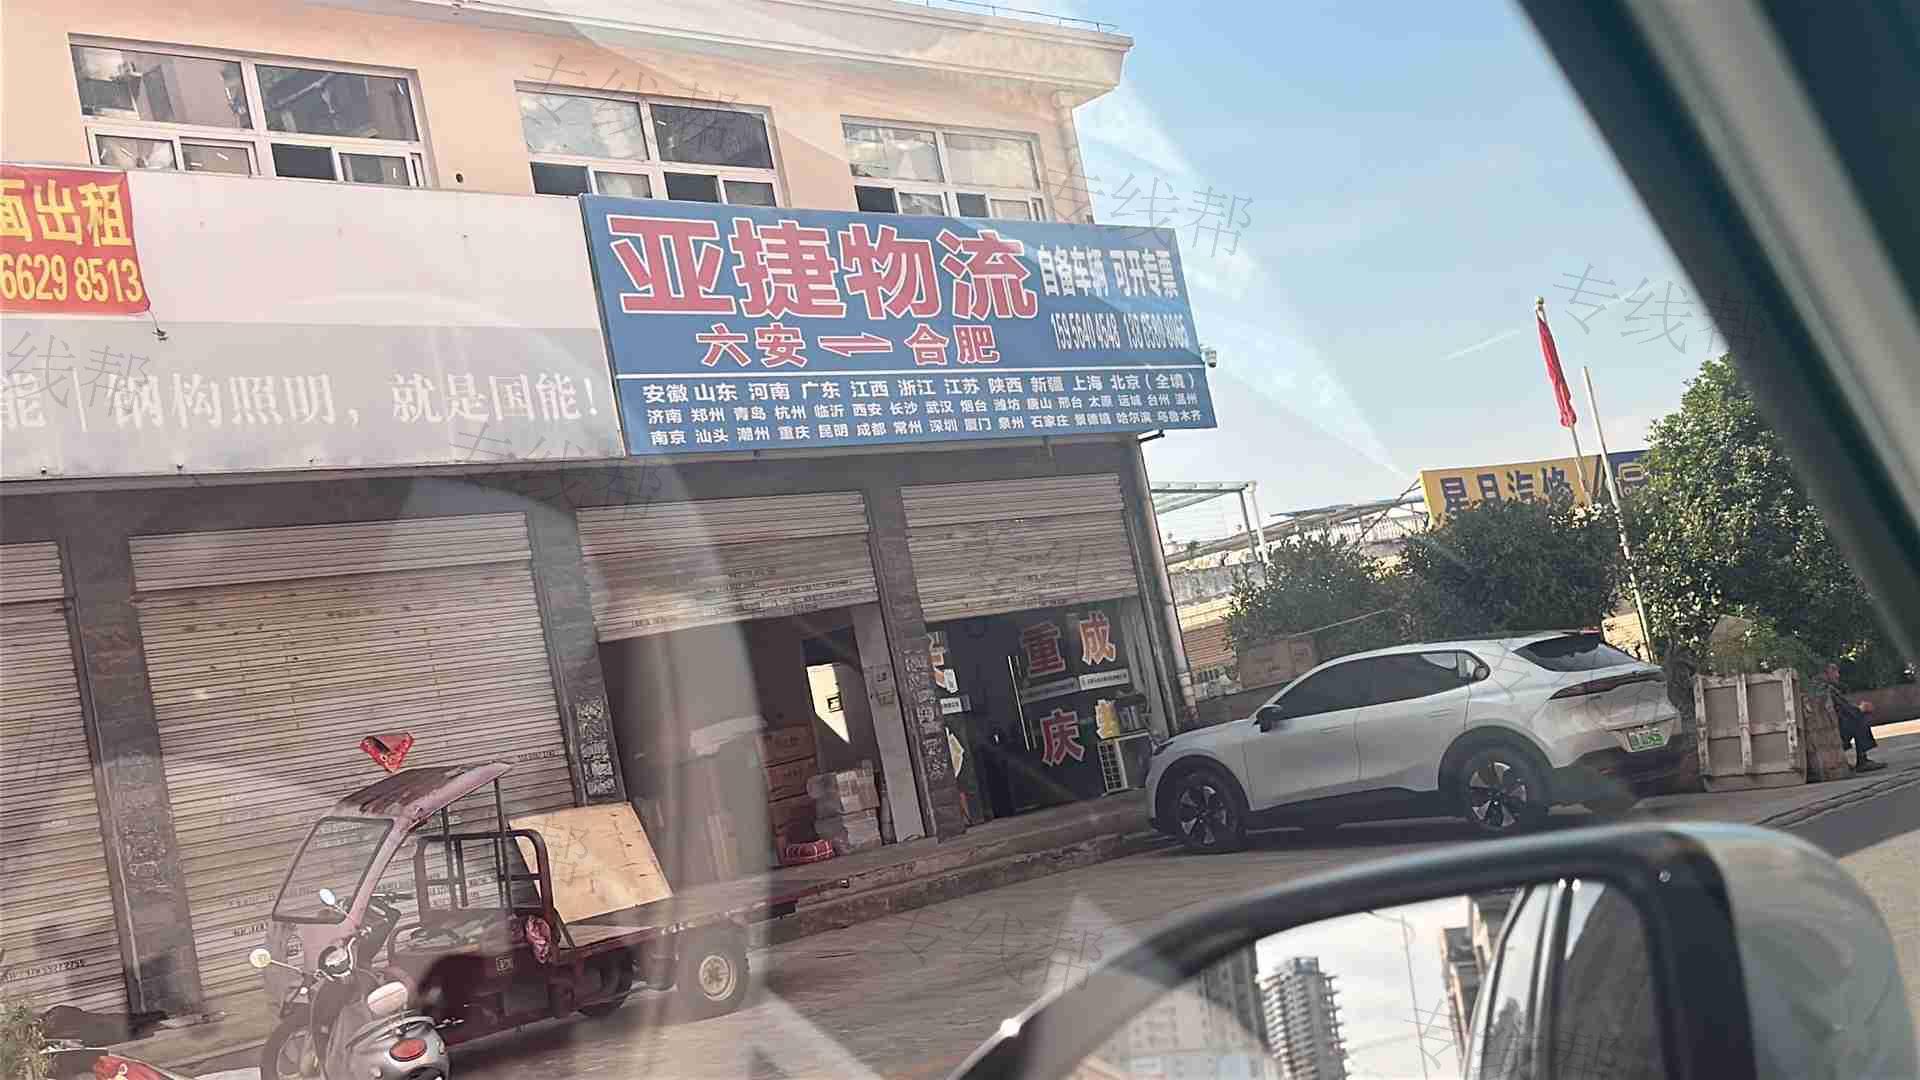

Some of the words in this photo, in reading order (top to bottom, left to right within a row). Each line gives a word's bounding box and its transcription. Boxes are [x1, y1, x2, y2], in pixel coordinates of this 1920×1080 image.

[0, 178, 133, 247] 面出租
[0, 253, 67, 301] 6629
[74, 256, 144, 302] 8513
[606, 213, 1039, 321] 亚捷物流
[1038, 244, 1108, 297] 自备车辆
[1110, 248, 1178, 299] 可开专票
[696, 322, 808, 369] 六安
[905, 324, 1002, 366] 合肥
[643, 384, 688, 404] 安徽
[694, 383, 737, 402] 山东
[748, 382, 791, 401] 河南
[800, 381, 840, 400] 广东
[851, 380, 889, 398] 江西
[897, 378, 936, 397] 浙江
[944, 377, 979, 394] 江苏
[988, 376, 1023, 394] 陕西
[1030, 375, 1064, 393] 新疆
[1072, 374, 1103, 391] 上海
[647, 407, 683, 425] 济南
[690, 406, 726, 423] 郑州
[733, 406, 766, 422] 青岛
[774, 405, 807, 420] 杭州
[814, 403, 846, 419] 临沂
[852, 402, 882, 418] 西安
[889, 400, 918, 416] 长沙
[926, 399, 954, 414] 武汉
[960, 398, 987, 413] 烟台
[1027, 396, 1052, 411] 唐山
[1148, 393, 1171, 406] 台州
[649, 430, 687, 446] 南京
[695, 428, 729, 444] 汕头
[736, 426, 770, 442] 潮州
[777, 425, 810, 441] 重庆
[818, 424, 849, 439] 昆明
[856, 422, 887, 437] 成都
[893, 420, 923, 435] 常州
[929, 417, 958, 433] 深圳
[964, 416, 992, 431] 厦门
[1030, 414, 1070, 429] 石家庄
